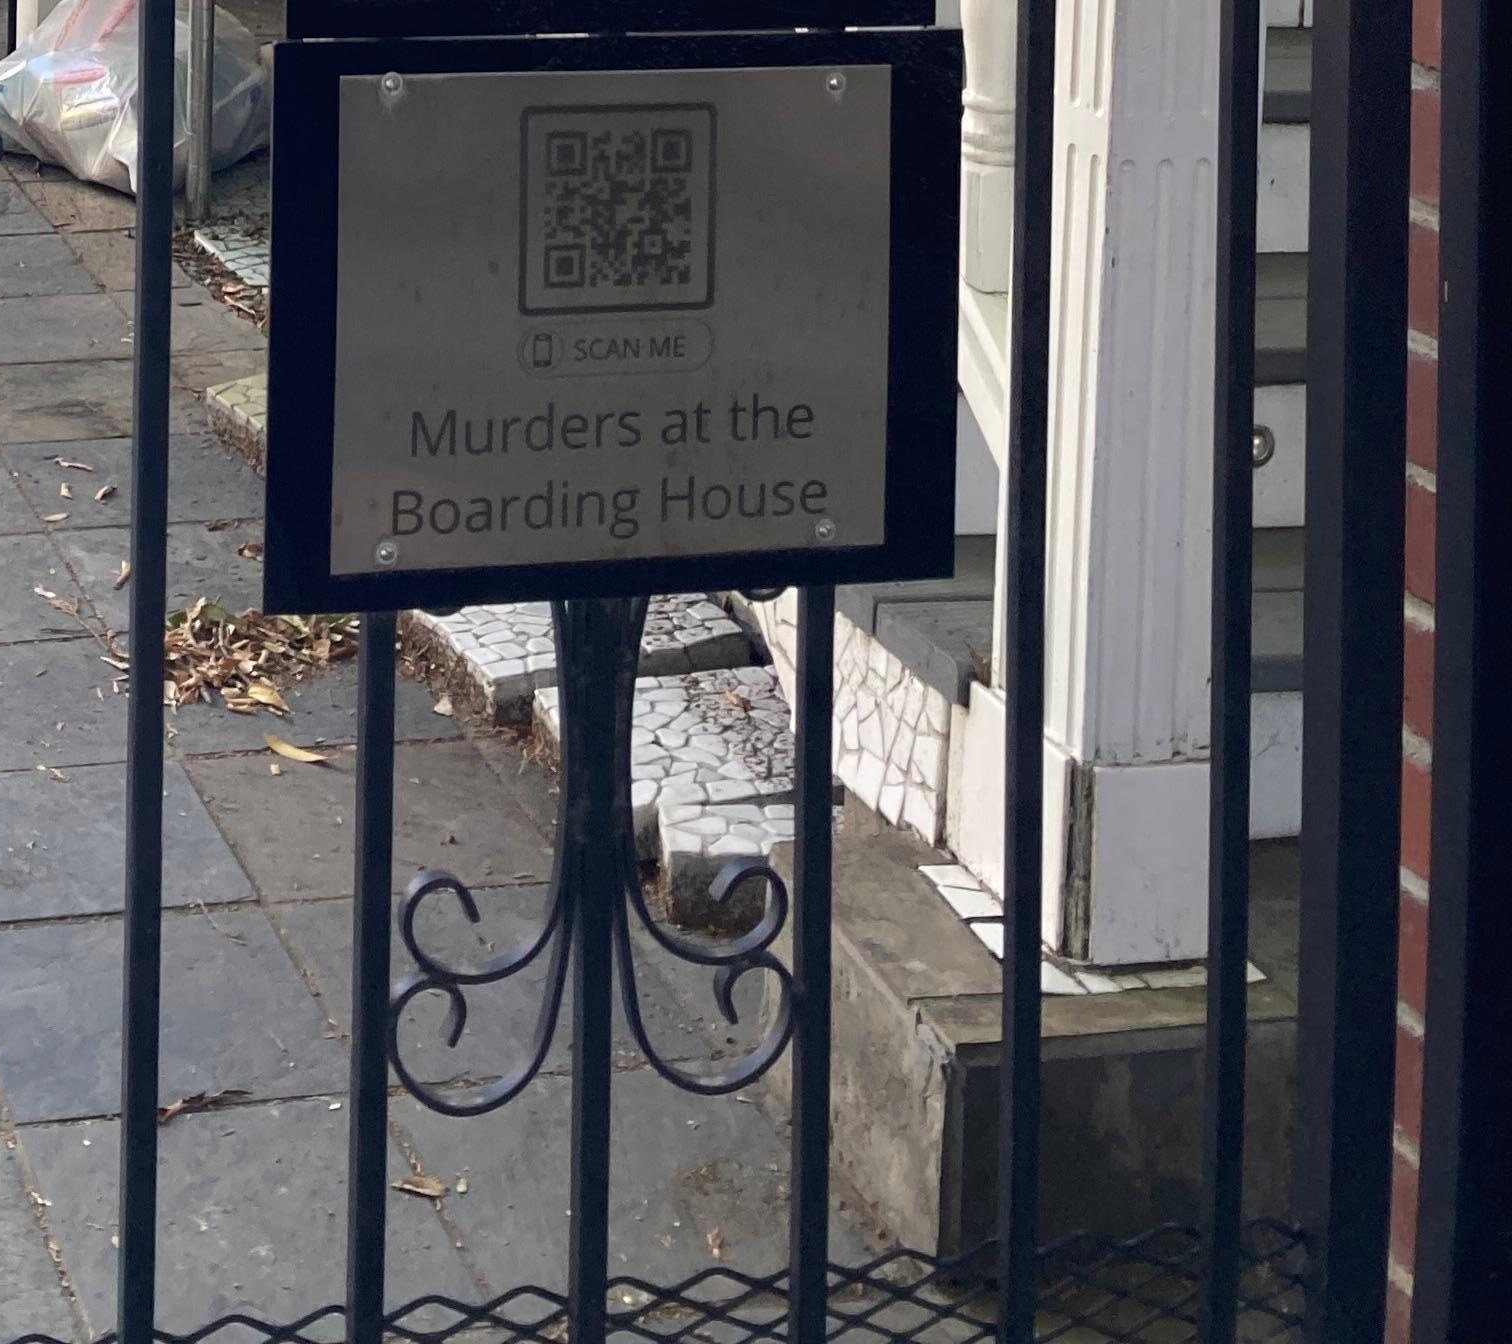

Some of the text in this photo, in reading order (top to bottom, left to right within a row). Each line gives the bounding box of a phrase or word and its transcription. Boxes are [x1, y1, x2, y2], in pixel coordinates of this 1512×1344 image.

[574, 336, 686, 362] SCAN ME
[410, 395, 814, 457] Murders at the
[392, 476, 827, 540] Boarding House
